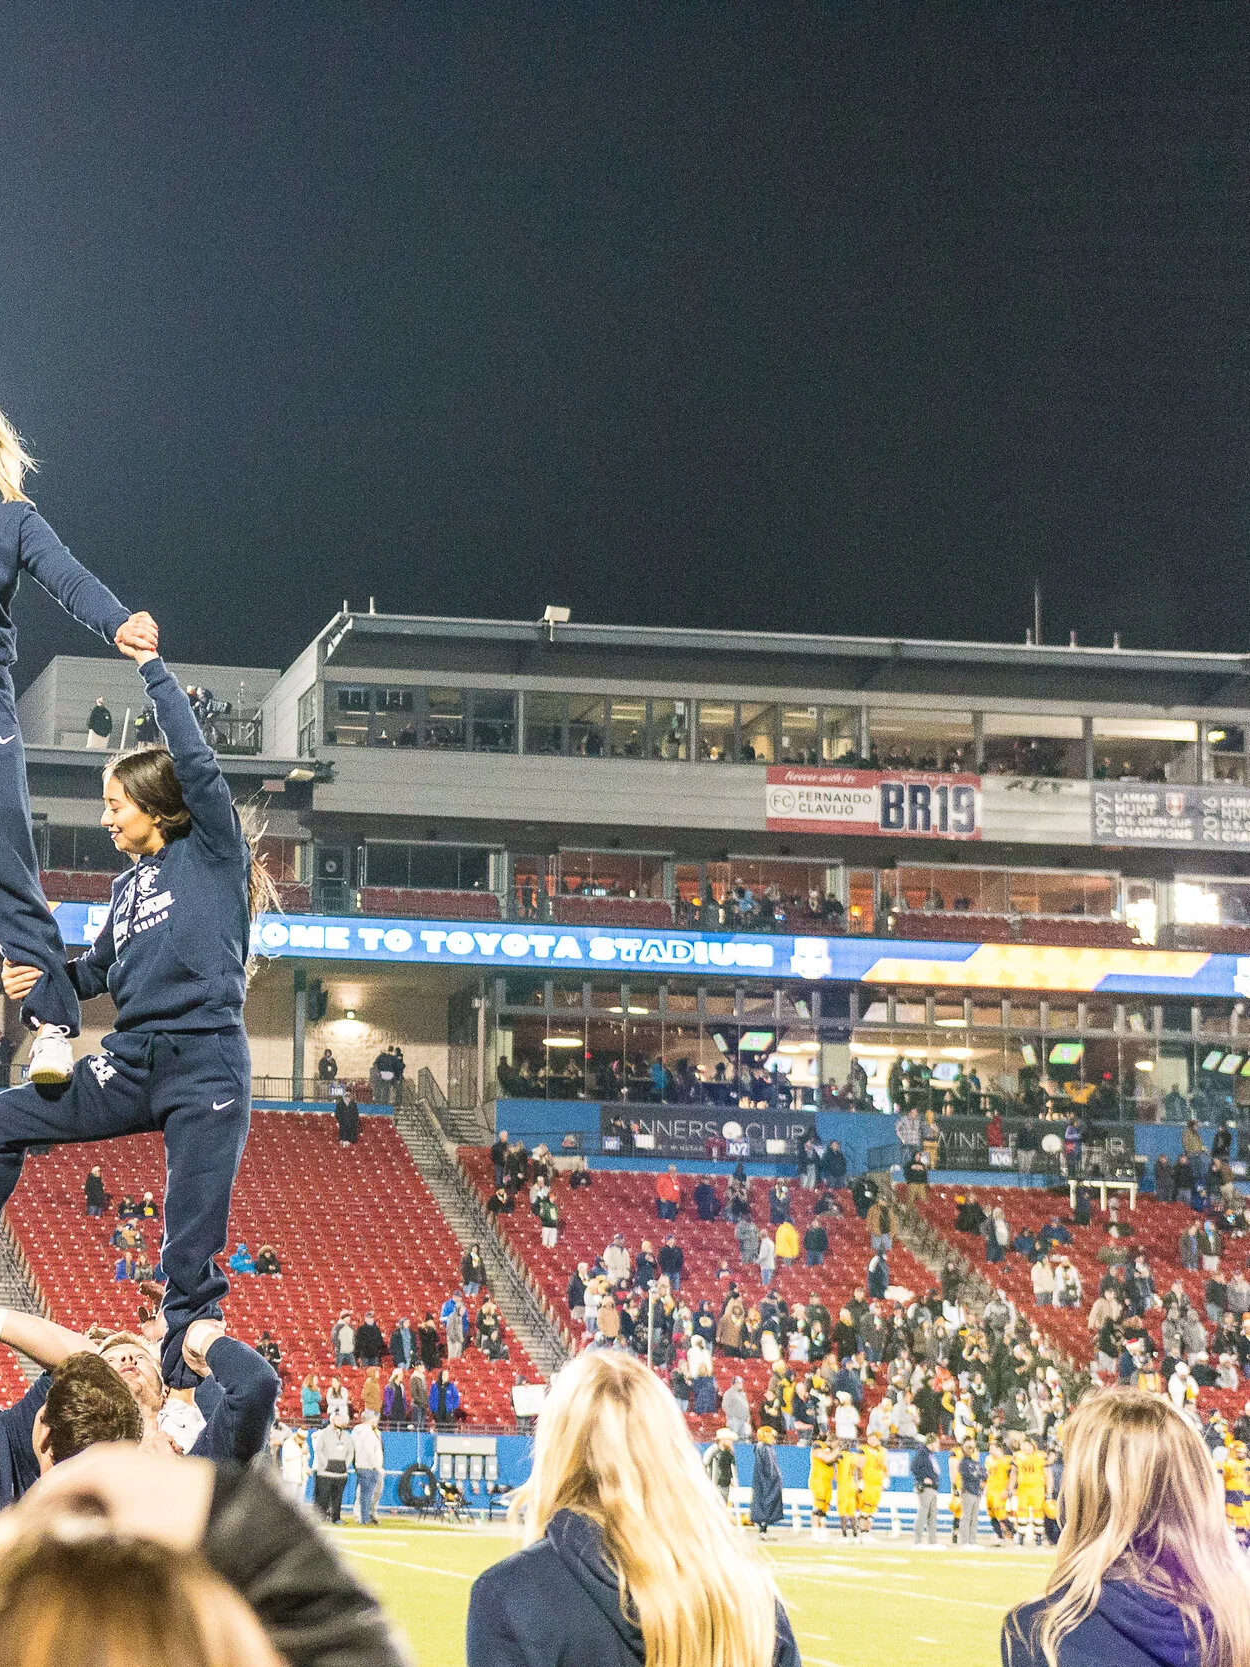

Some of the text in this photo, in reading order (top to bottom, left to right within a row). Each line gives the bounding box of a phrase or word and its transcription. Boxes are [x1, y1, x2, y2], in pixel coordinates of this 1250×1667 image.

[773, 794, 792, 808] FC
[798, 791, 872, 805] FERNANDO
[798, 803, 854, 816] CLAVIJO
[879, 782, 975, 834] BR19
[1114, 803, 1158, 817] HUNT
[1202, 796, 1218, 840] 2016
[1114, 826, 1194, 840] CHAMPIONS
[358, 928, 413, 953] TO
[420, 930, 583, 959] TOYOTA
[588, 936, 774, 968] STADIUM
[729, 1142, 748, 1157] 107
